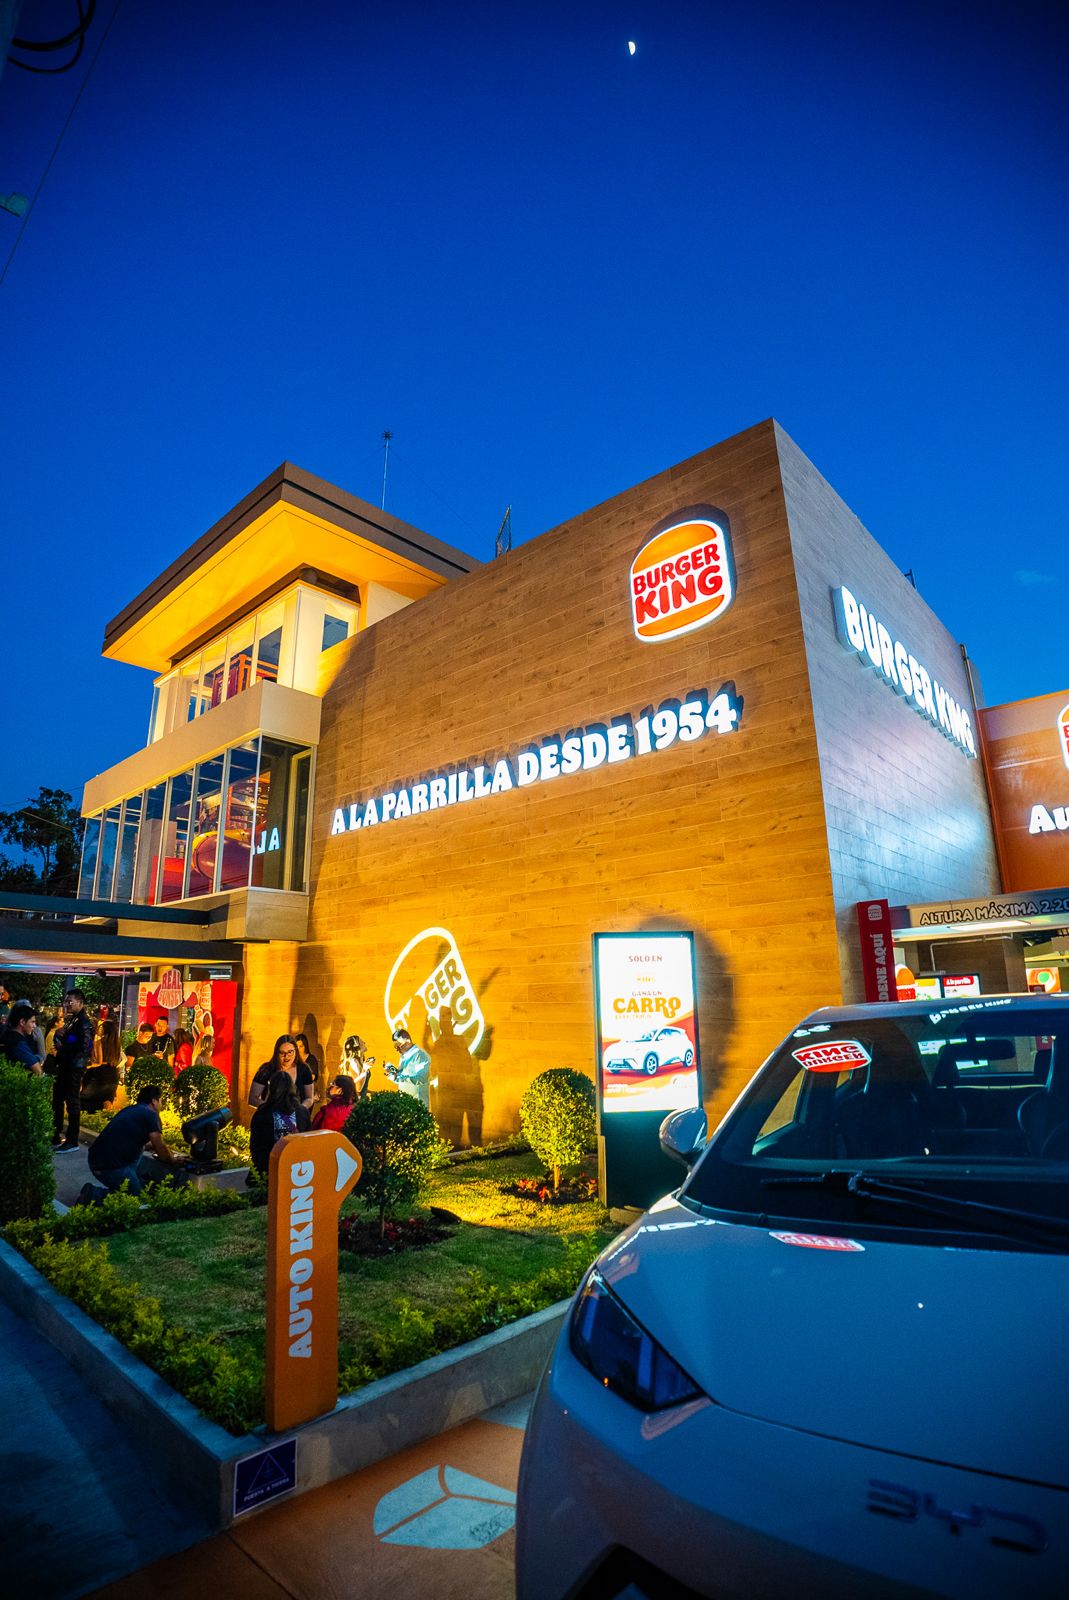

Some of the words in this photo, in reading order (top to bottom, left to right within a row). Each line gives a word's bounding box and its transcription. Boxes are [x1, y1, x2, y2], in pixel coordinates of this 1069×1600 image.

[633, 543, 720, 595] BURGER
[635, 565, 723, 624] KING
[841, 585, 938, 720] BURGER
[934, 680, 975, 754] KING
[331, 808, 346, 836] A
[349, 799, 378, 831] LA
[382, 759, 513, 823] PARRILLA
[518, 724, 630, 785] DESDE
[635, 694, 737, 754] 1954
[920, 908, 973, 926] ALTURA
[976, 902, 1038, 920] MÁXIMA
[870, 933, 886, 965] AQUÍ
[162, 969, 182, 989] REAL
[613, 996, 682, 1019] CARRO
[290, 1160, 315, 1256] KING
[288, 1257, 314, 1359] AUTO
